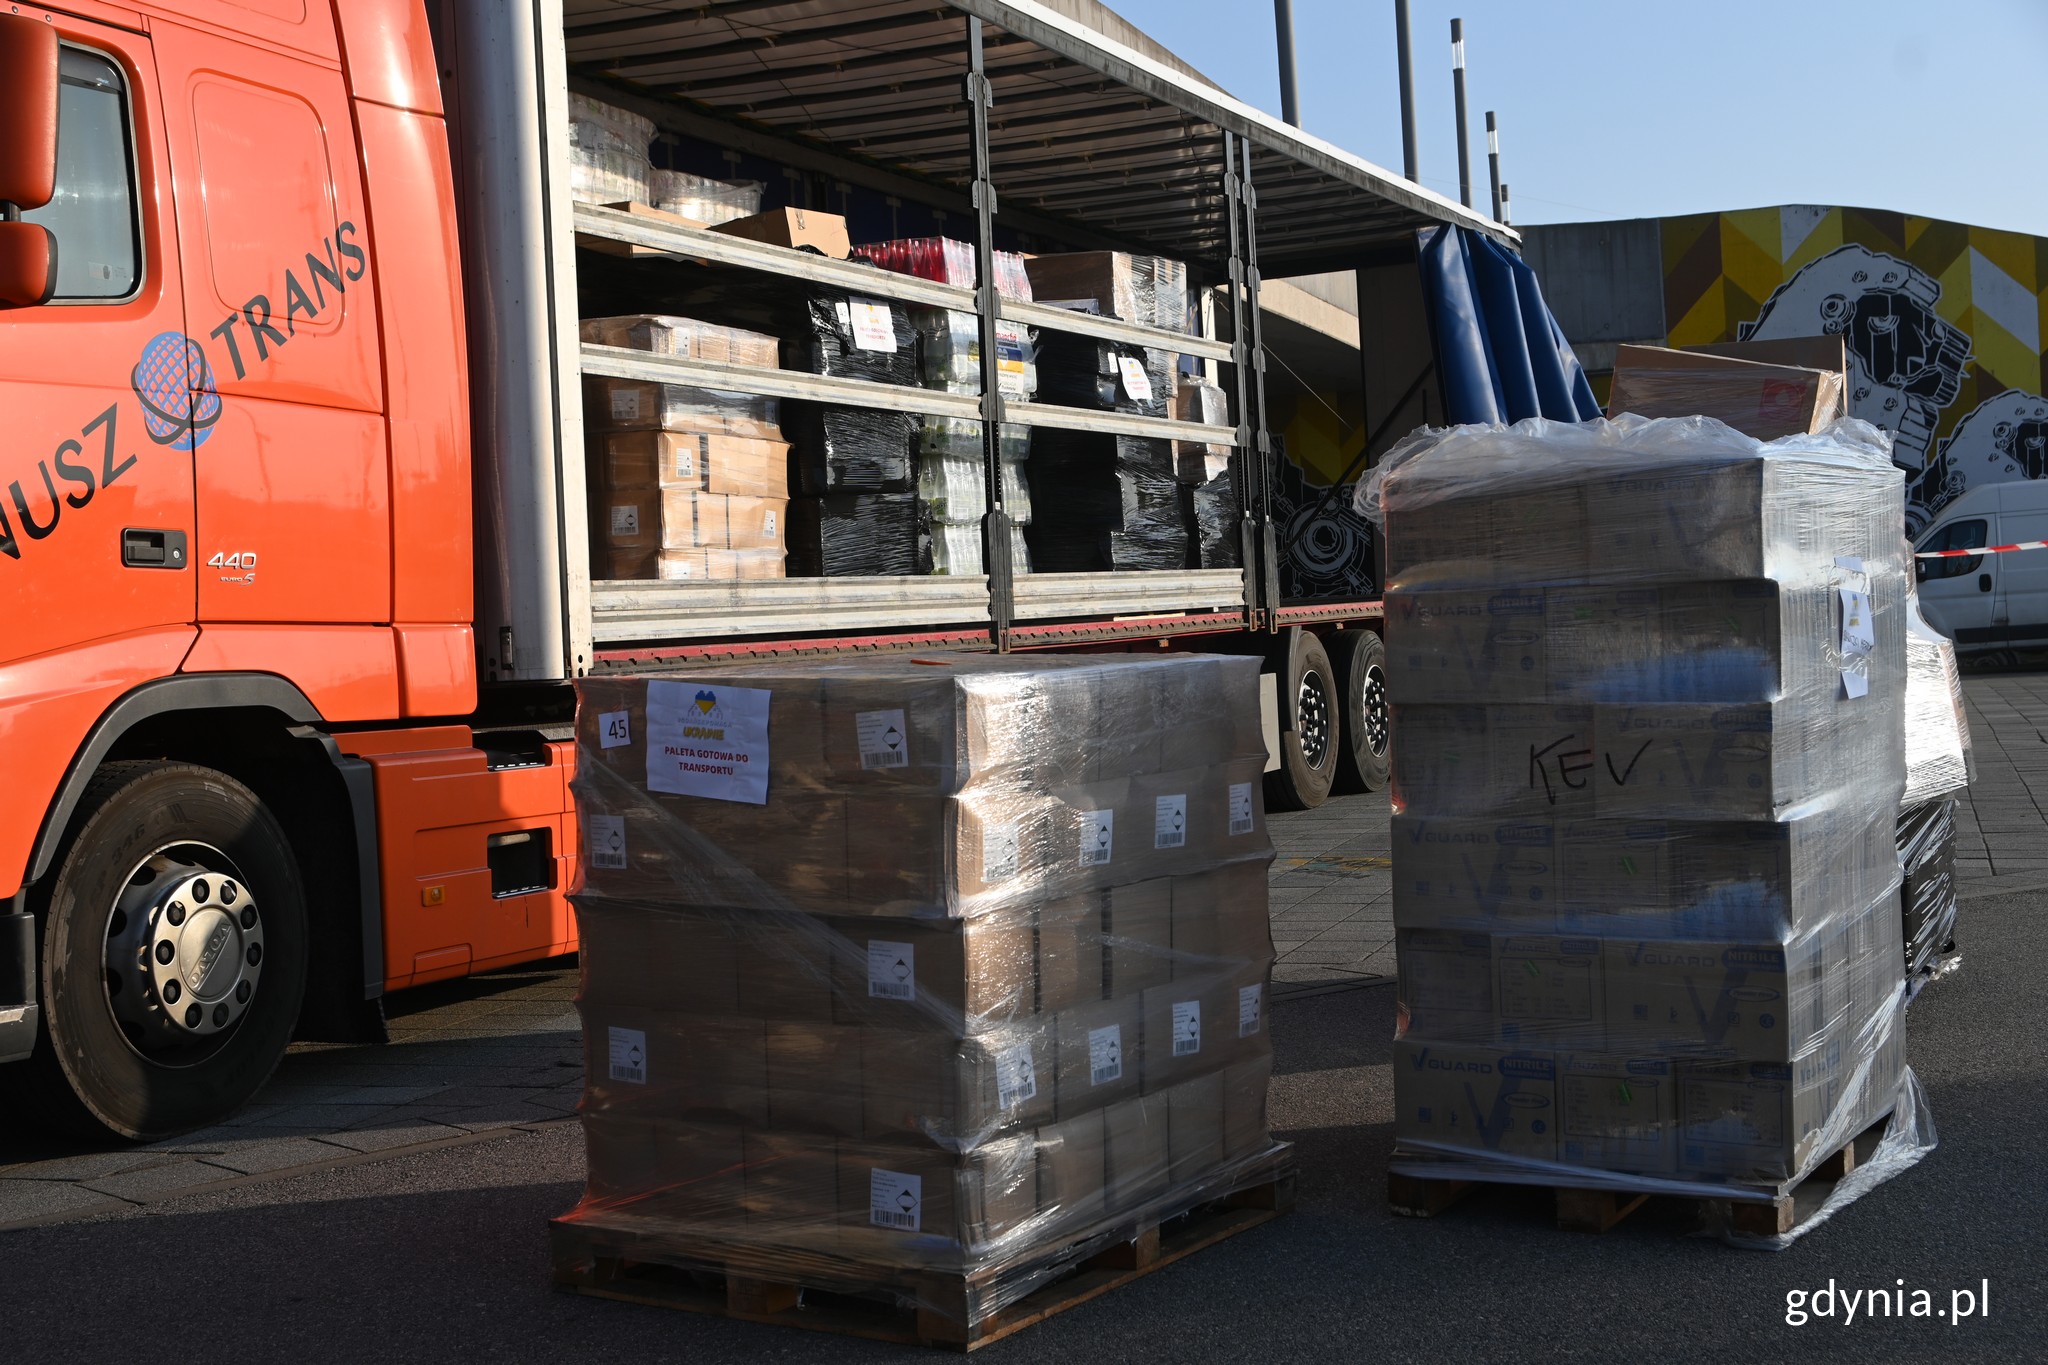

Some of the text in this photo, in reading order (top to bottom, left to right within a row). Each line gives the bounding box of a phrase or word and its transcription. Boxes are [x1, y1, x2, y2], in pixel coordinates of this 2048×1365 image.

[210, 221, 365, 381] TRANS
[206, 551, 256, 570] 440
[609, 720, 627, 739] 45
[665, 746, 749, 763] PALETA GOTOWA DO
[679, 762, 734, 776] TRANSPORTU
[1529, 734, 1653, 807] KEV
[1407, 821, 1490, 847] VGUARD
[190, 919, 232, 988] VOLVO
[1625, 941, 1715, 967] VGUARD
[1727, 950, 1780, 963] NITRILE
[1410, 1047, 1493, 1075] VGUARD
[1504, 1058, 1551, 1071] NITRILE
